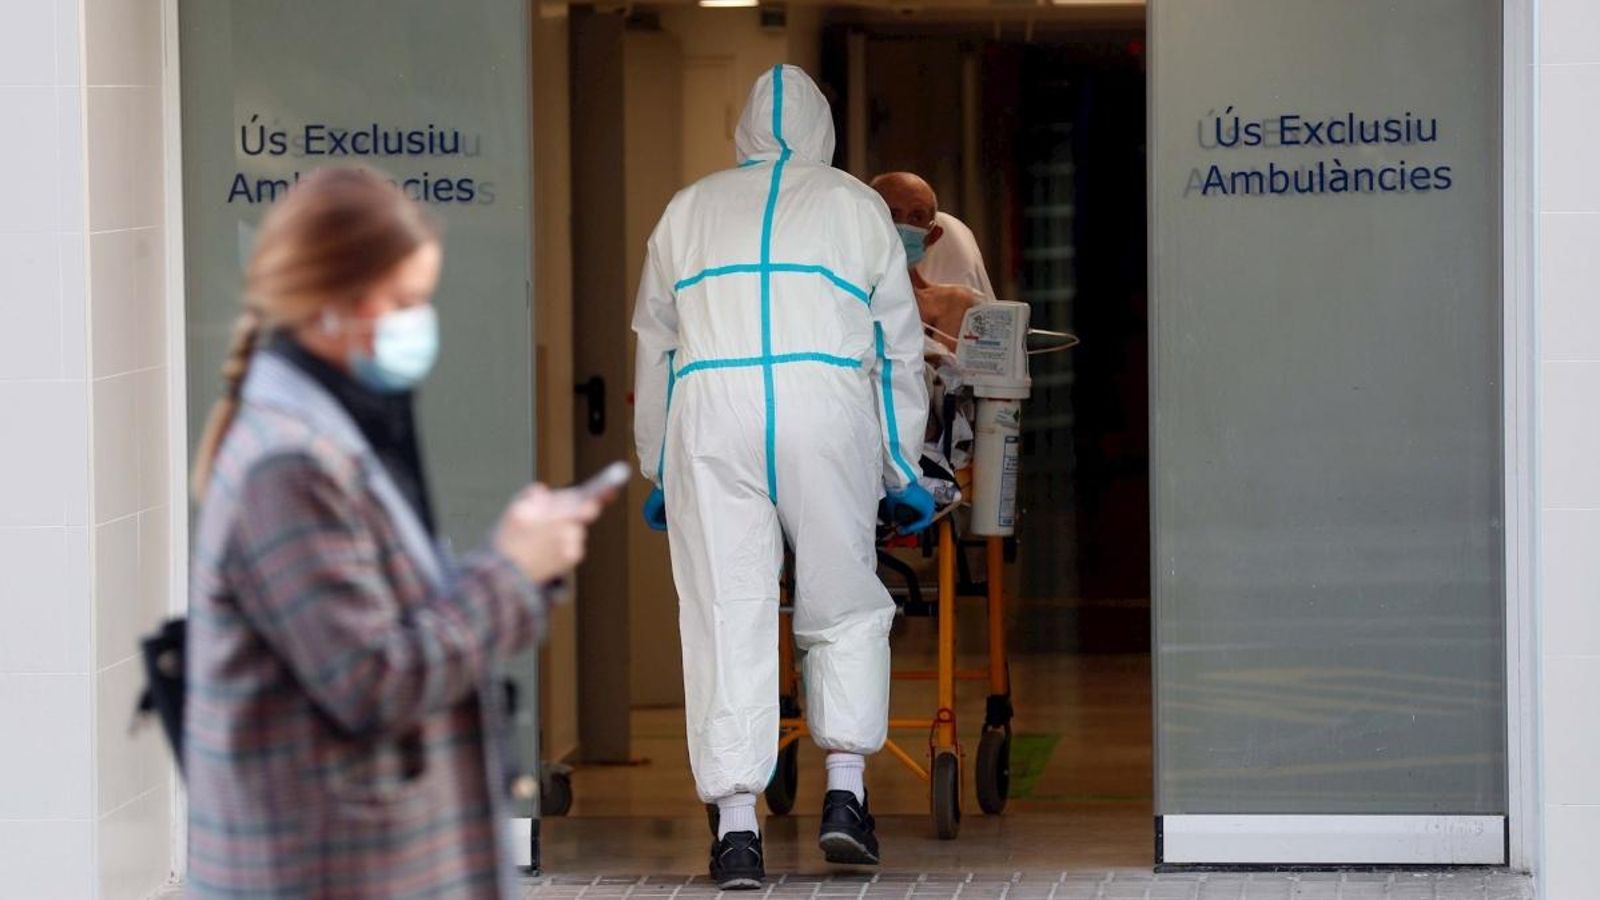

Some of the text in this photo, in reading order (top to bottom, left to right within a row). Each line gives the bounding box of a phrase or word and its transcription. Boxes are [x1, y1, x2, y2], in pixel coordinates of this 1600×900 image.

[241, 114, 459, 155] Ús Exclusiu
[1215, 106, 1437, 147] Ús Exclusiu
[228, 172, 475, 203] Amcies
[1202, 158, 1453, 195] Ambulàncies
